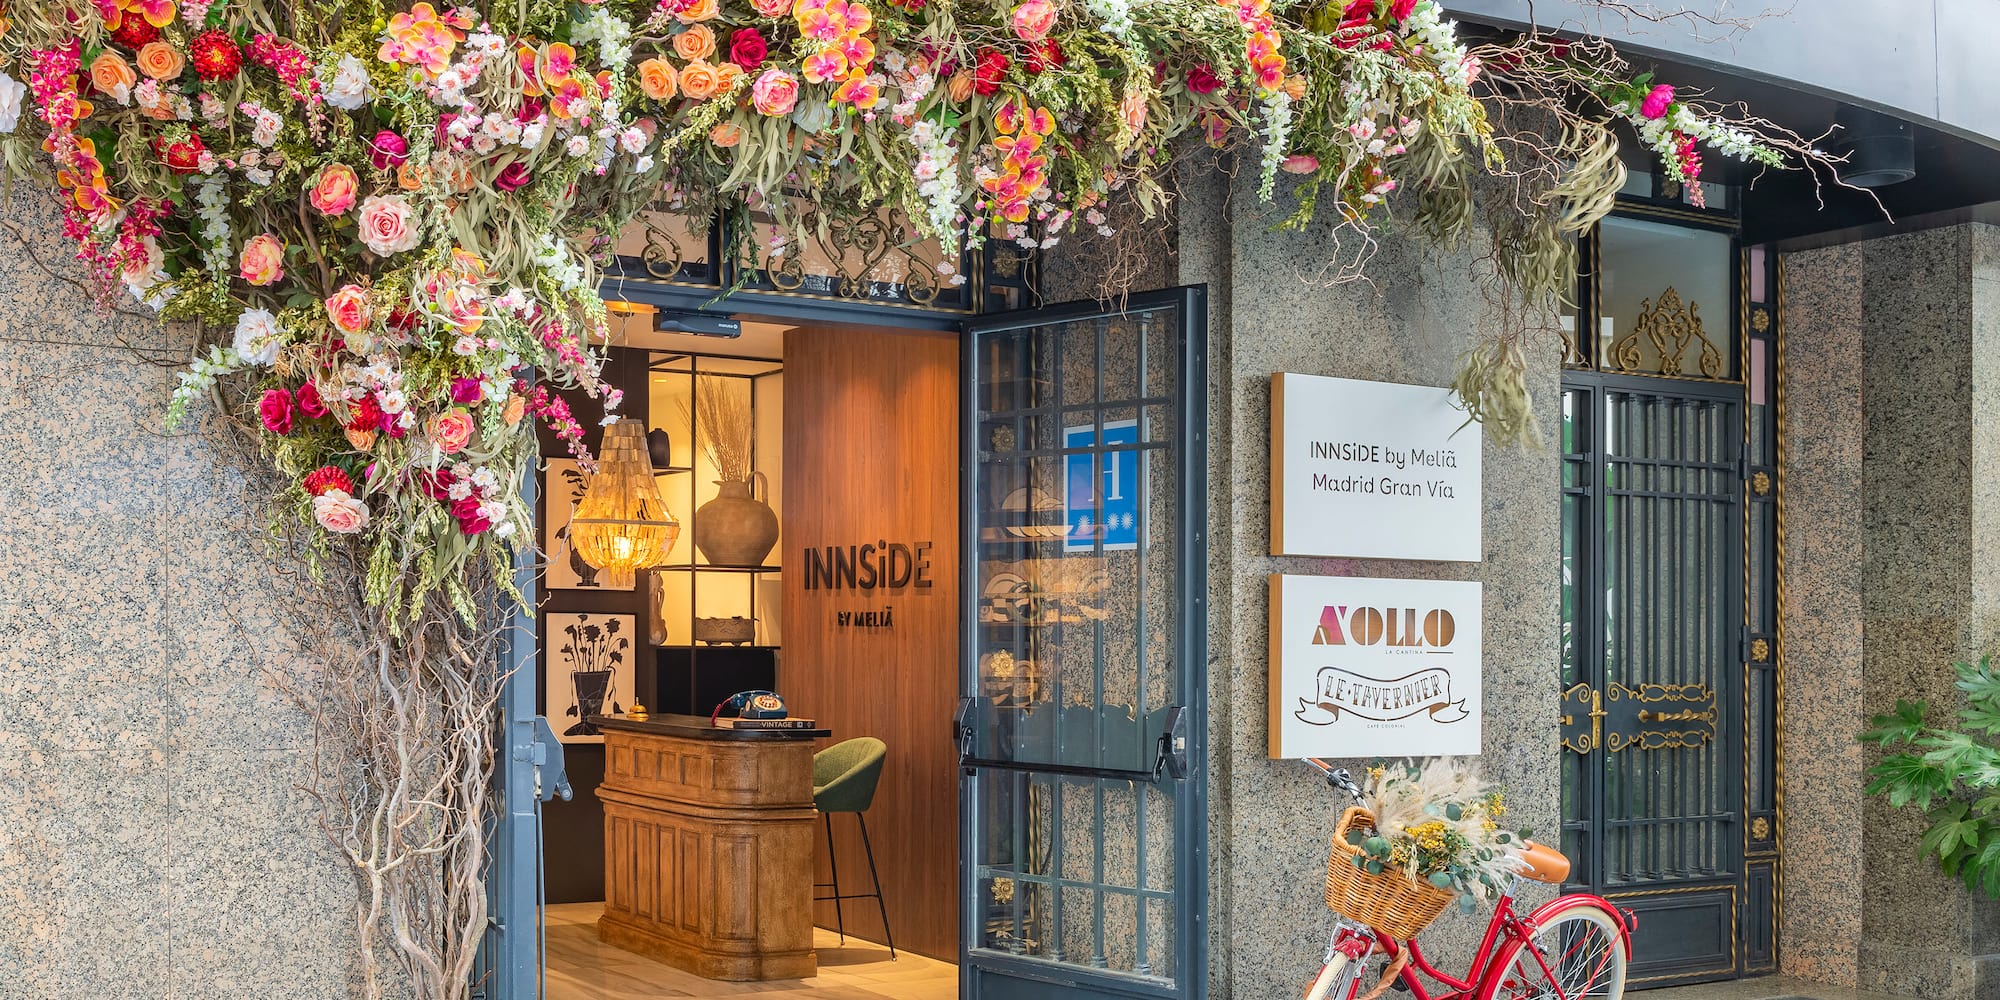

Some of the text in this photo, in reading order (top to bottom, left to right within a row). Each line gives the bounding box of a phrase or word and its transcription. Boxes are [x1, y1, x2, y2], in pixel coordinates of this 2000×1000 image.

[1310, 441, 1380, 463] INNSiDE
[1385, 446, 1406, 470] by
[1313, 473, 1455, 499] Madrid Gran Vía
[804, 539, 933, 590] INNSiDE
[838, 611, 850, 626] BY
